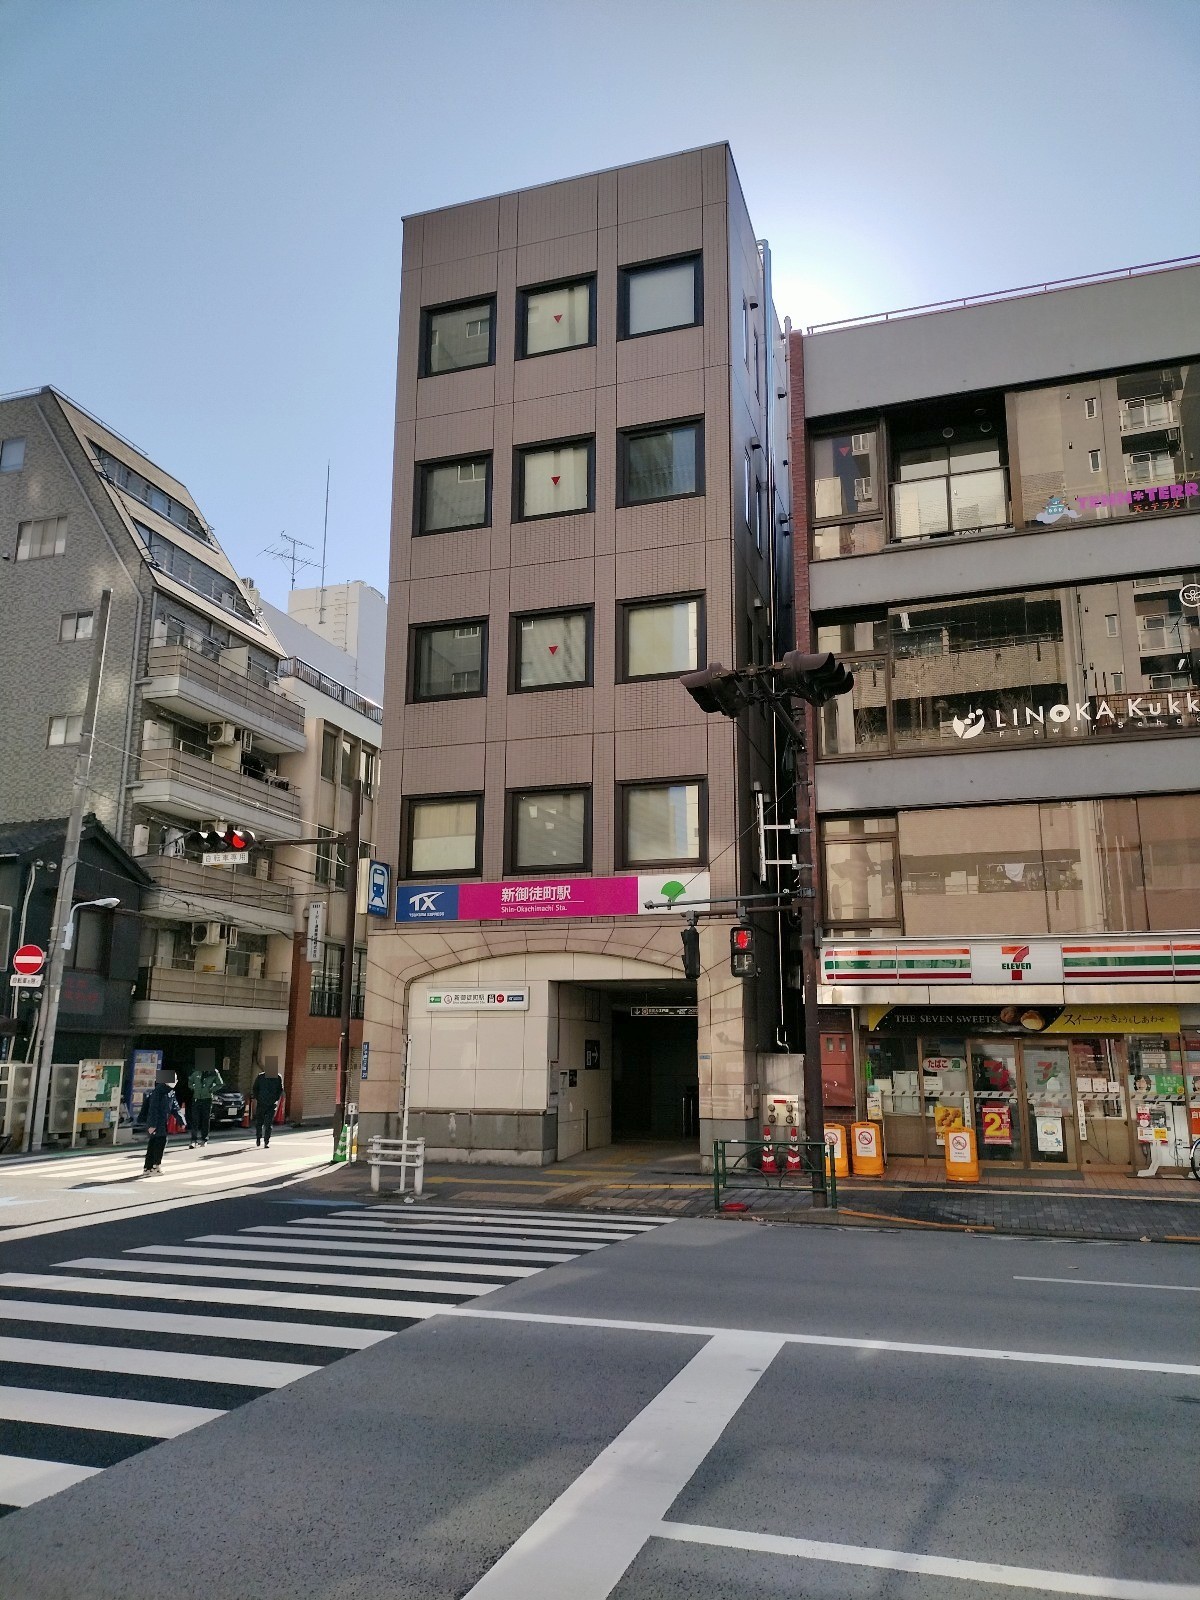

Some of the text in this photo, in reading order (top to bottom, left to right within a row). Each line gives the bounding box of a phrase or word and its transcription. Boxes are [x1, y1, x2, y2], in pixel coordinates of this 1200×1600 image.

[996, 700, 1115, 728] LINOKA
[205, 853, 246, 862] 自転車専用
[501, 885, 571, 902] 新御徒町駅
[409, 892, 445, 911] TX
[501, 904, 568, 913] Shin-Okachimachi Sta.
[895, 1015, 998, 1024] THE SEVEN SWEETS
[927, 1059, 948, 1069] たばこ
